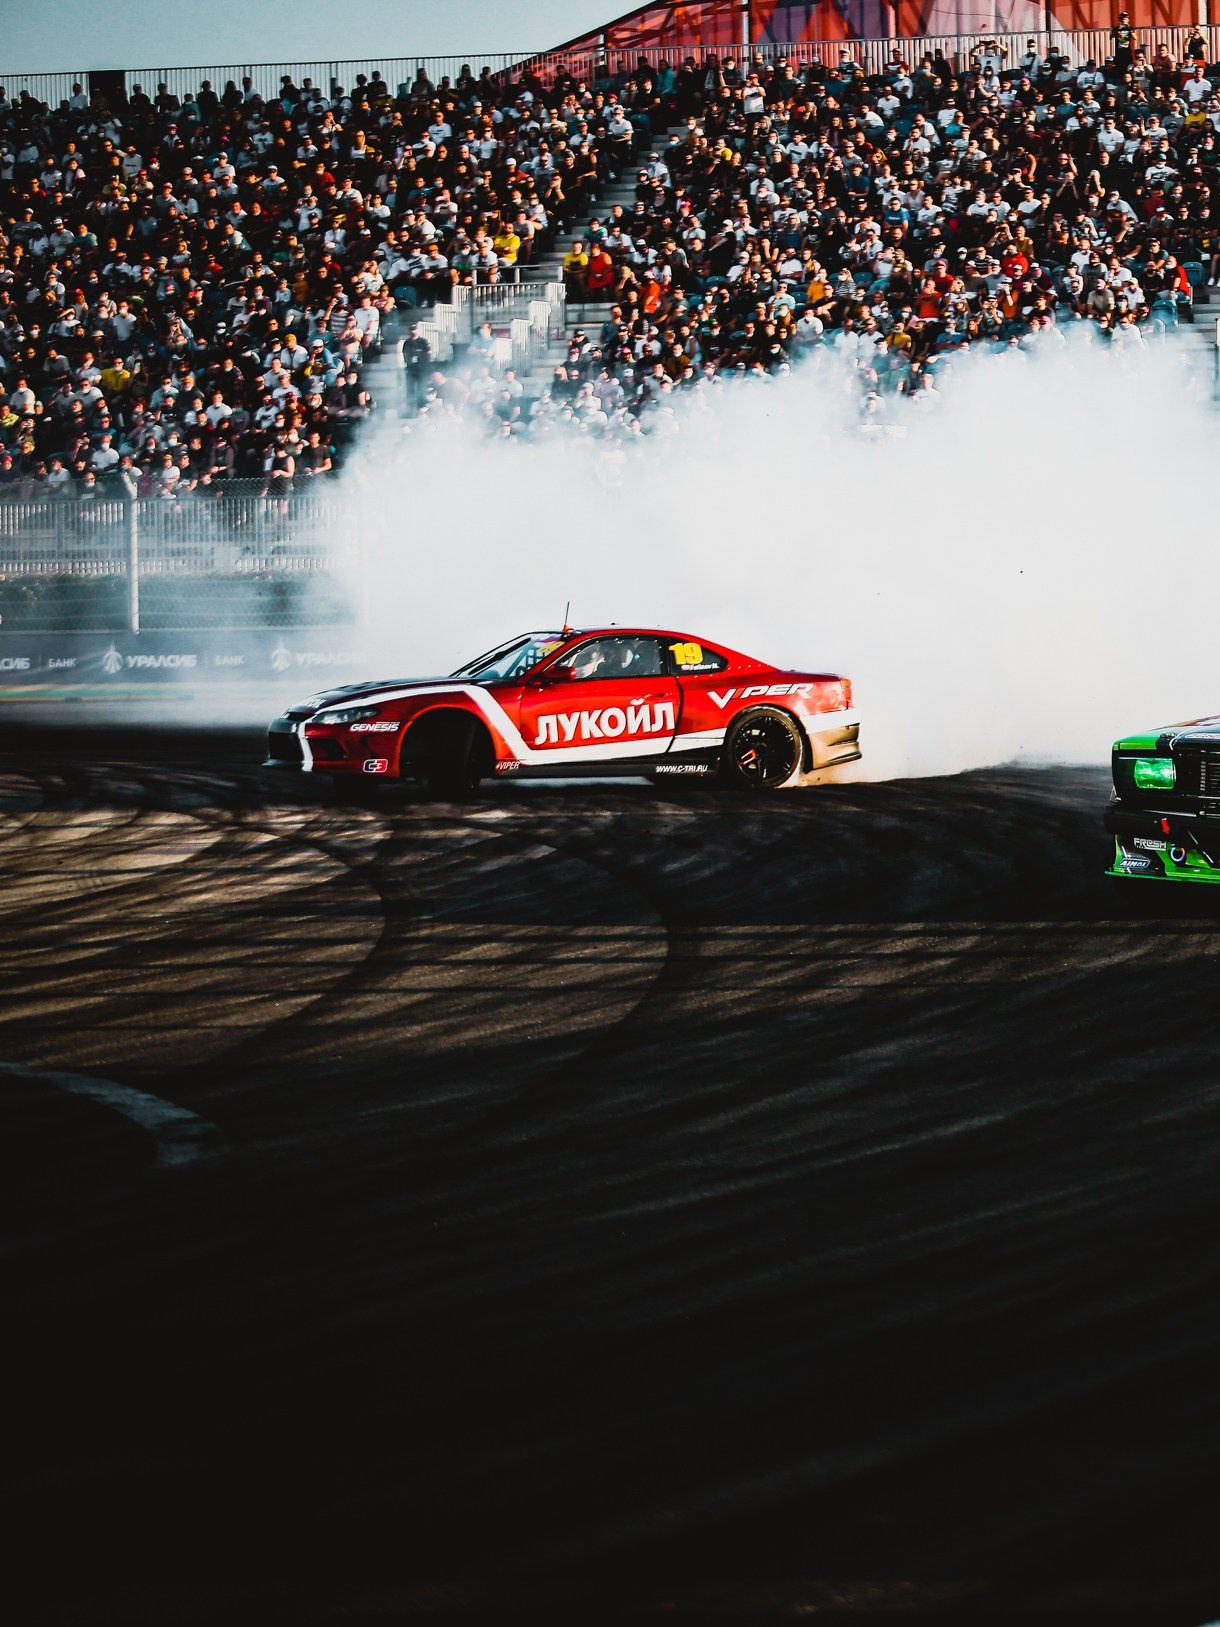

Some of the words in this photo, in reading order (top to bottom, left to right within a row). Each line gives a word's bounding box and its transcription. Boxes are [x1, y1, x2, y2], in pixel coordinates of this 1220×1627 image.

[668, 642, 704, 665] 19
[0, 657, 31, 670] СИБ
[48, 658, 77, 668] БАНК
[127, 654, 198, 668] УРАЛСИБ
[215, 655, 246, 665] БАНК
[707, 683, 814, 709] VIPER
[535, 697, 675, 745] ЛУКОЙЛ
[349, 723, 399, 733] GENESIS
[495, 761, 521, 771] #VIPER
[1133, 838, 1167, 851] FRESH
[1119, 859, 1148, 868] AIMOL
